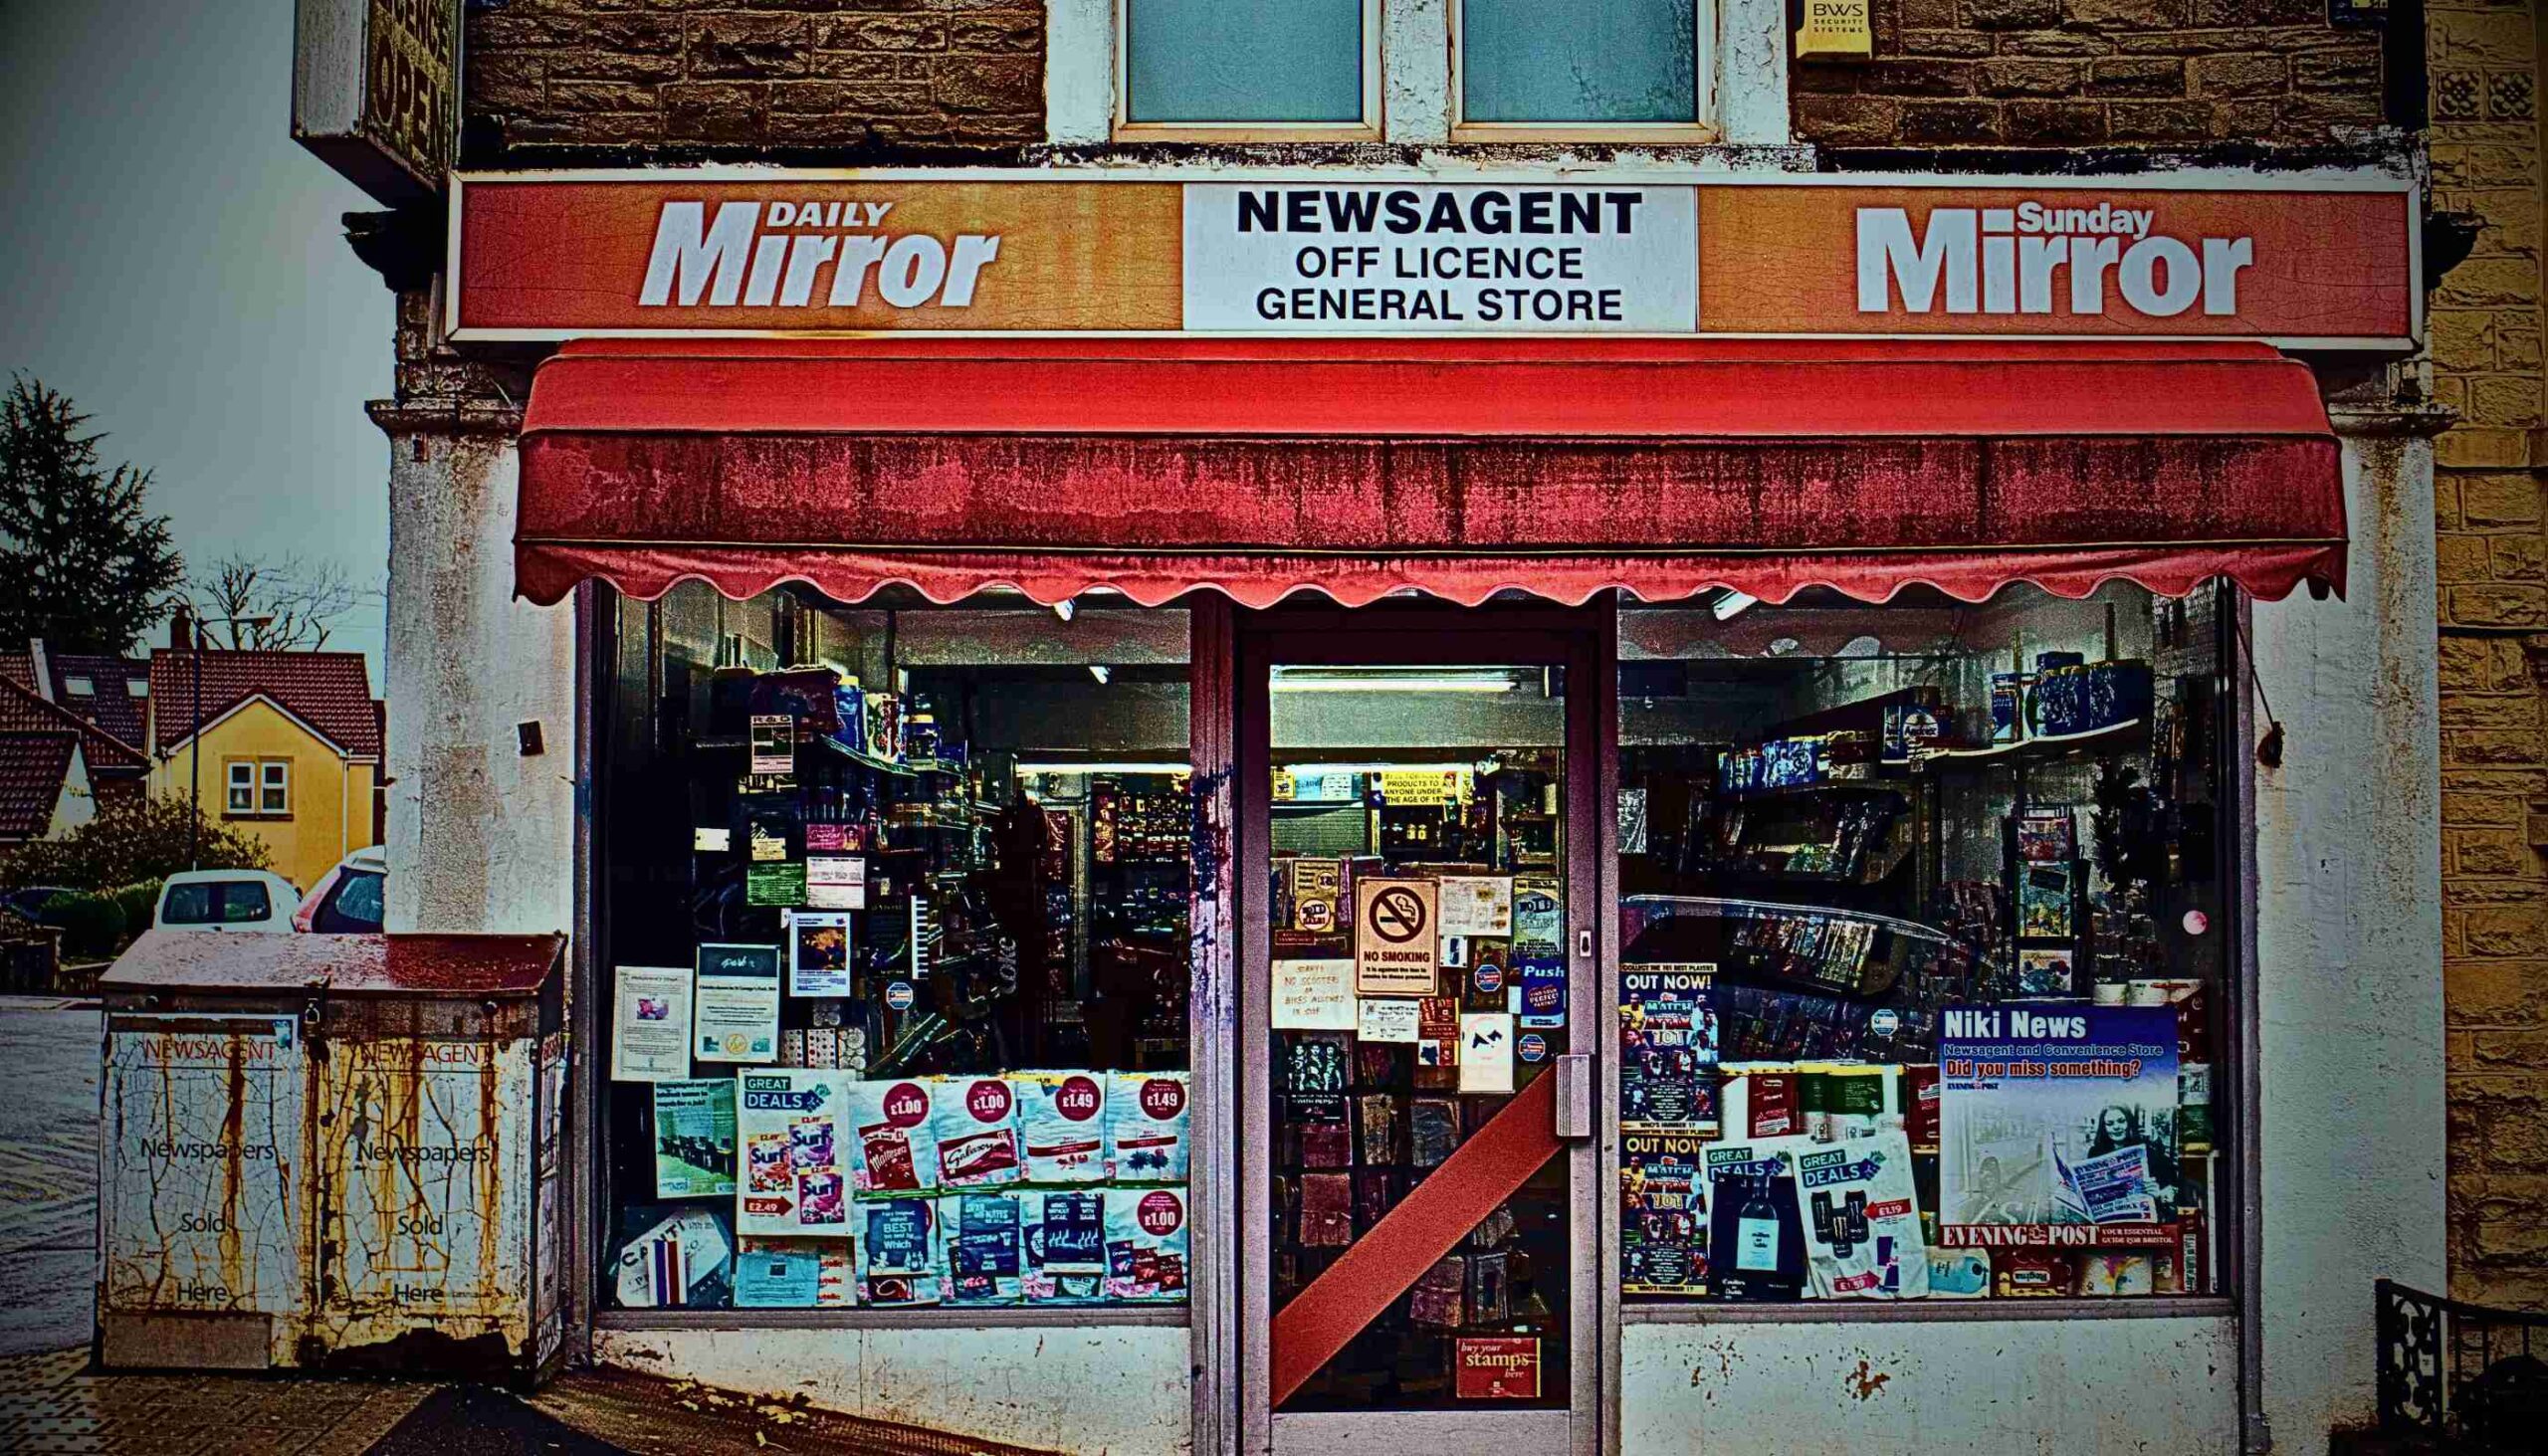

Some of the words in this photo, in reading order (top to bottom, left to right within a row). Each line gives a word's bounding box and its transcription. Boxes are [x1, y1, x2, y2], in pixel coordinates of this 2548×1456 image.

[1813, 3, 1863, 17] BWS
[374, 33, 448, 173] OPEN
[765, 202, 894, 228] DAILY
[1237, 190, 1642, 235] NEWSAGENT
[2017, 201, 2154, 240] Sunday
[637, 200, 1001, 309] Mirror
[1295, 246, 1380, 280] OFF
[1394, 246, 1584, 280] LICENCE
[1856, 206, 2253, 316] Mirror
[1256, 287, 1464, 321] GENERAL
[1477, 288, 1623, 321] STORE
[1364, 951, 1380, 962] NO
[1381, 951, 1430, 962] SMOKING
[1524, 965, 1565, 977] Push
[1625, 974, 1659, 990] OUT
[1663, 974, 1712, 990] NOW!
[1646, 1001, 1692, 1010] MATCH
[1944, 1010, 2001, 1039] Niki
[2011, 1010, 2087, 1039] News
[144, 1039, 275, 1061] NEWSAGENT
[1943, 1045, 2016, 1058] Newsagent
[2016, 1045, 2040, 1056] and
[2043, 1045, 2126, 1056] Convenience
[2128, 1045, 2164, 1056] Store
[1946, 1060, 1973, 1077] Did
[1977, 1063, 2005, 1080] you
[2009, 1060, 2045, 1077] miss
[2048, 1060, 2141, 1080] something?
[747, 1078, 789, 1090] GREAT
[746, 1093, 803, 1109] DEALS
[890, 1099, 923, 1116] £1.00
[973, 1095, 1005, 1111] £1.00
[1062, 1093, 1094, 1108] £1.49
[1147, 1092, 1178, 1107] £1.49
[791, 1126, 832, 1146] Surf
[140, 1138, 275, 1162] Newspaers
[1626, 1138, 1659, 1152] OUT
[358, 1142, 490, 1166] Newspapers
[750, 1146, 787, 1163] Surf
[1708, 1149, 1750, 1162] GREAT
[1803, 1153, 1843, 1168] GREAT
[1646, 1165, 1692, 1174] MATCH
[1805, 1164, 1861, 1187] DEALS
[802, 1178, 837, 1196] Surf
[747, 1201, 778, 1212] £2.49
[1878, 1205, 1903, 1216] £1.19
[180, 1212, 227, 1234] Sold
[397, 1215, 444, 1237] Sold
[1145, 1211, 1176, 1227] £1.00
[883, 1223, 914, 1233] BEST
[1943, 1225, 2027, 1245] EVENING
[2048, 1225, 2100, 1245] POST
[176, 1281, 227, 1303] Here
[394, 1284, 445, 1306] Here
[1460, 1341, 1479, 1354] buy
[1479, 1344, 1502, 1355] your
[1465, 1352, 1530, 1371] stamps
[1504, 1367, 1525, 1378] here
